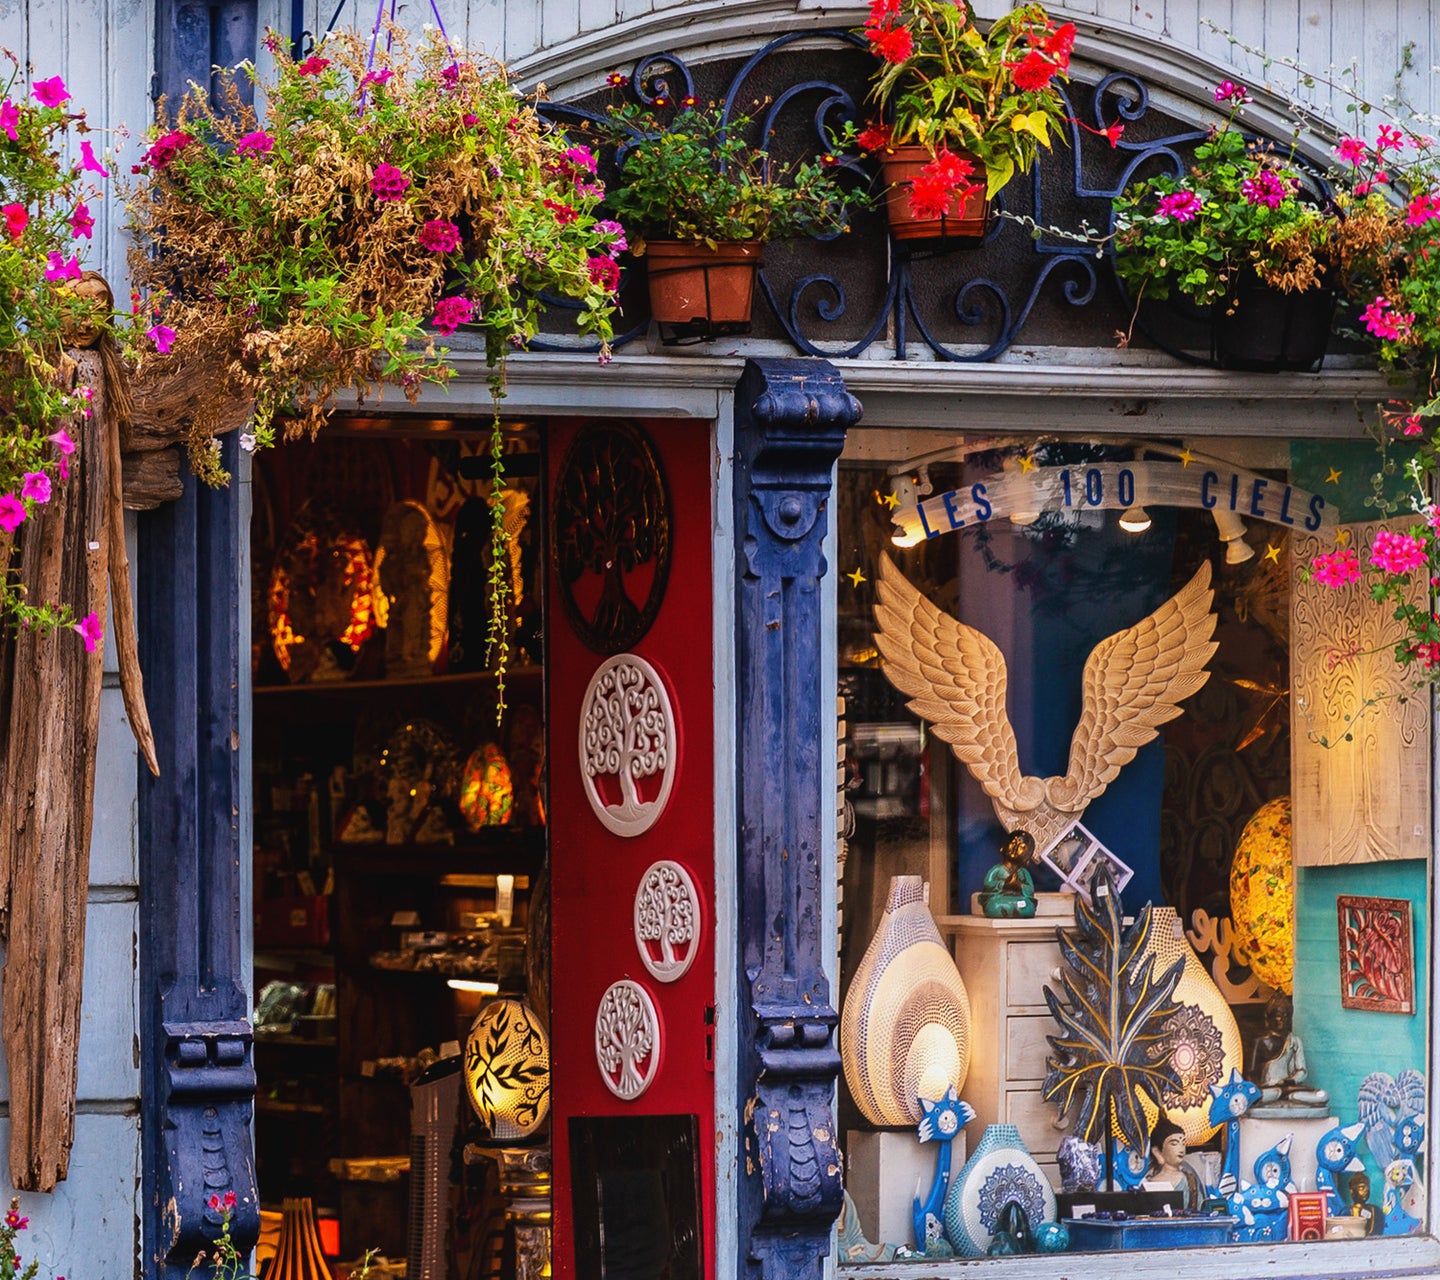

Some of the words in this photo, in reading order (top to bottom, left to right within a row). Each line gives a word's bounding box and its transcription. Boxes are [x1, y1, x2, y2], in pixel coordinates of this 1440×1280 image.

[916, 483, 993, 540] LES
[1060, 469, 1134, 507] 100
[1201, 471, 1325, 532] CIELS
